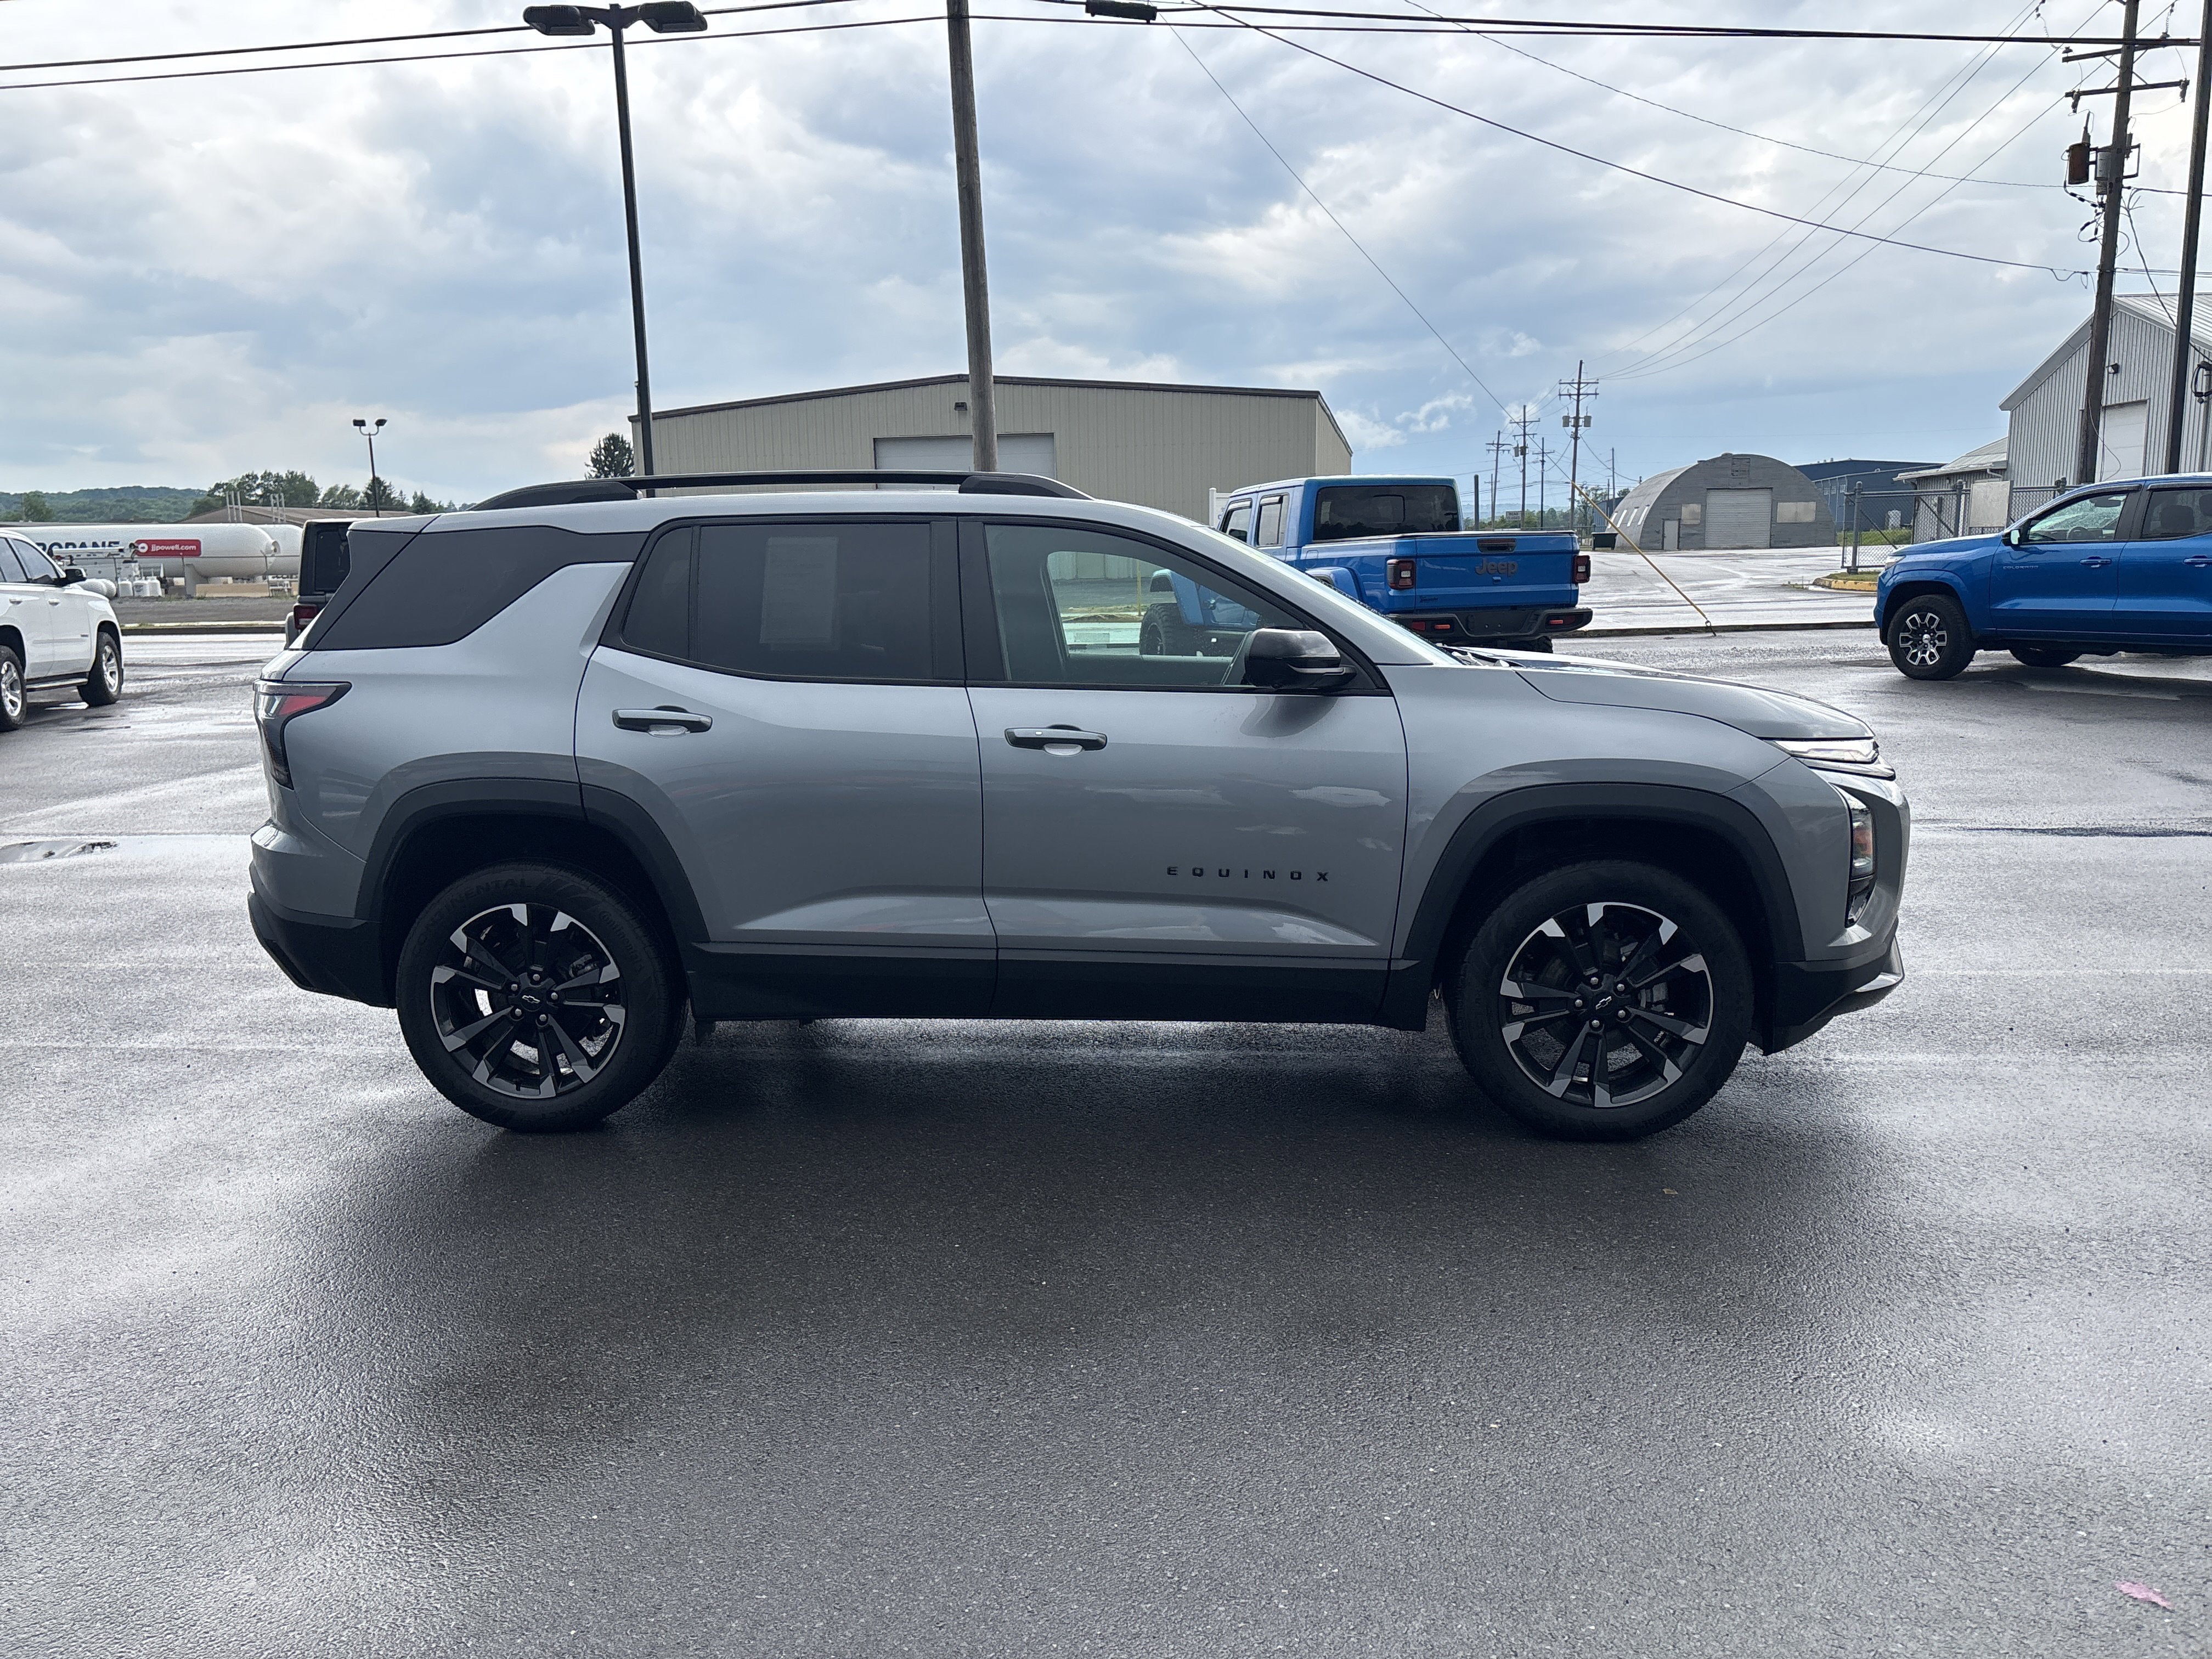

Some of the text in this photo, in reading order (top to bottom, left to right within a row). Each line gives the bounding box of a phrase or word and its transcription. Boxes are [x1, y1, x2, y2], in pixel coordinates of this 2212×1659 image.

[35, 541, 120, 554] ROPANE
[1475, 558, 1518, 577] Jeep
[1166, 866, 1328, 881] EQUINOX
